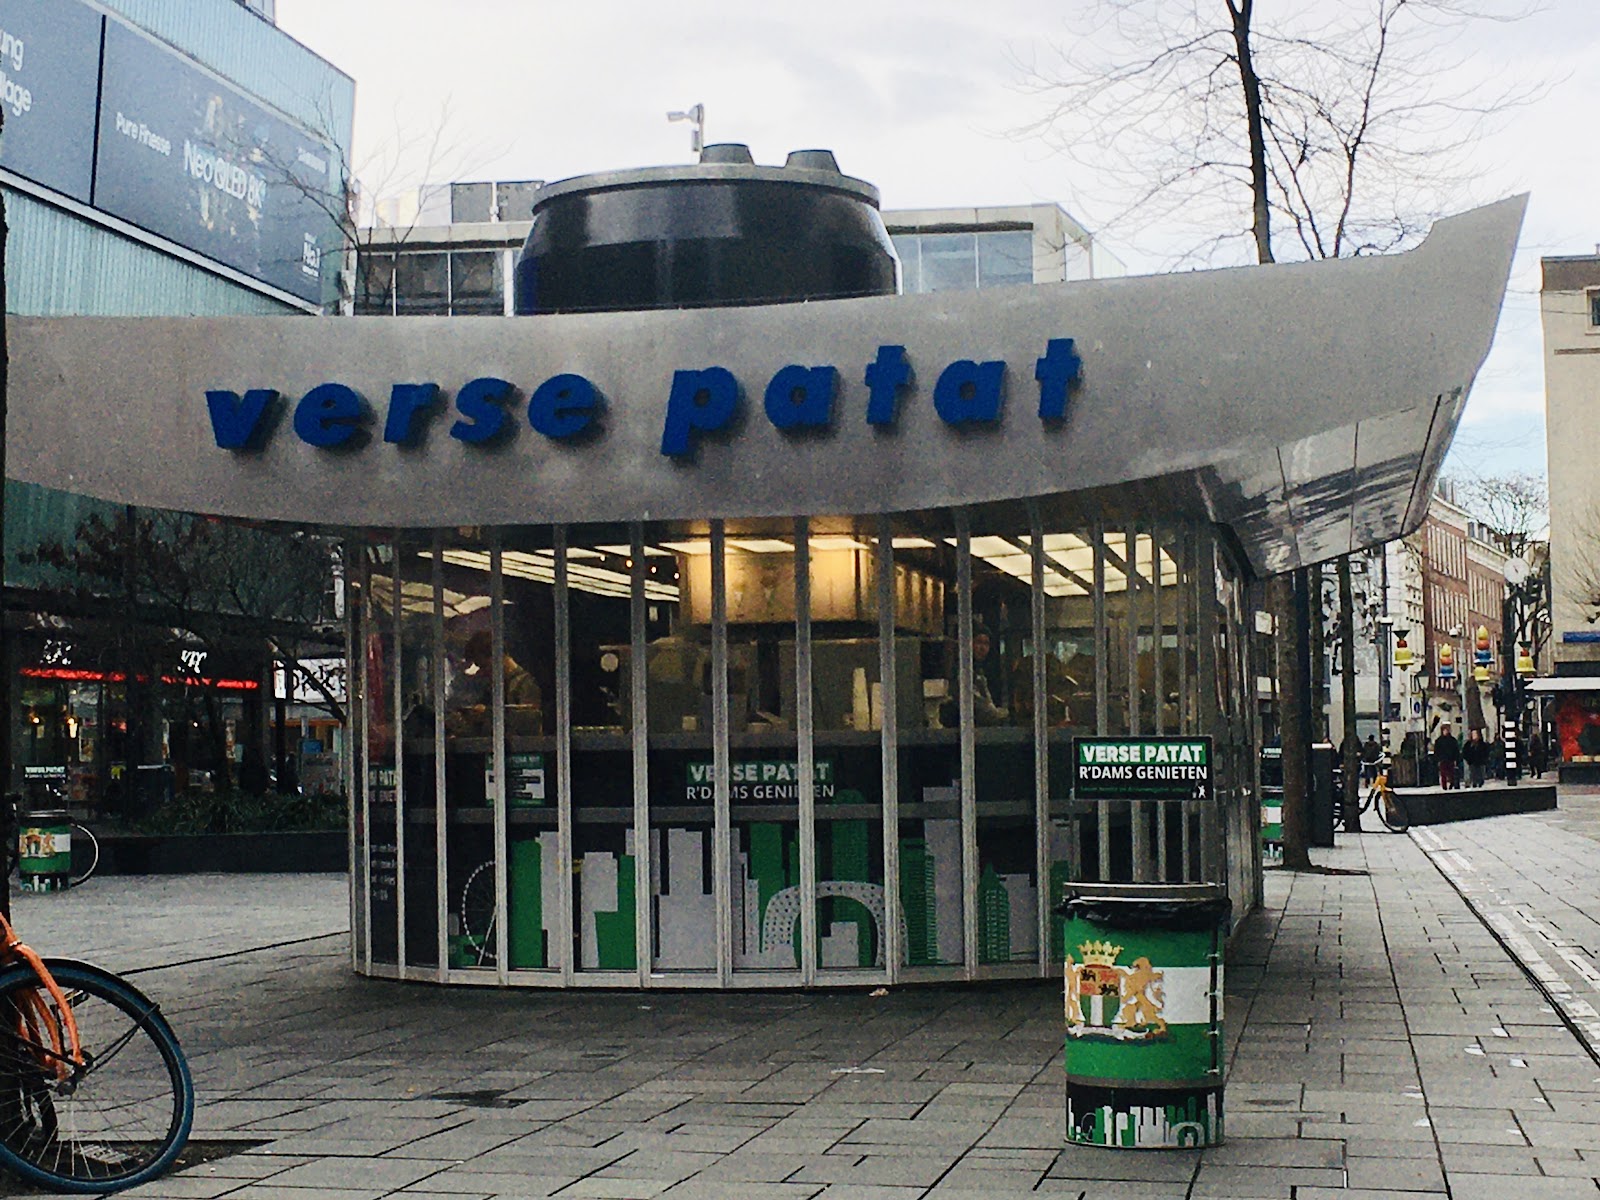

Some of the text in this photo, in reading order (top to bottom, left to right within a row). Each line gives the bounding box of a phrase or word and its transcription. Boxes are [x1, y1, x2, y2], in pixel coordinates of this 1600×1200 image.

[115, 111, 138, 139] Pure
[184, 138, 214, 183] Neo
[214, 157, 247, 200] QLED
[204, 337, 1083, 457] verse patat
[1082, 745, 1203, 762] VERSE PATAT
[690, 762, 830, 782] VESE PATT
[1079, 766, 1208, 779] R'DAMS GENIETEN
[686, 785, 749, 800] R'DMS
